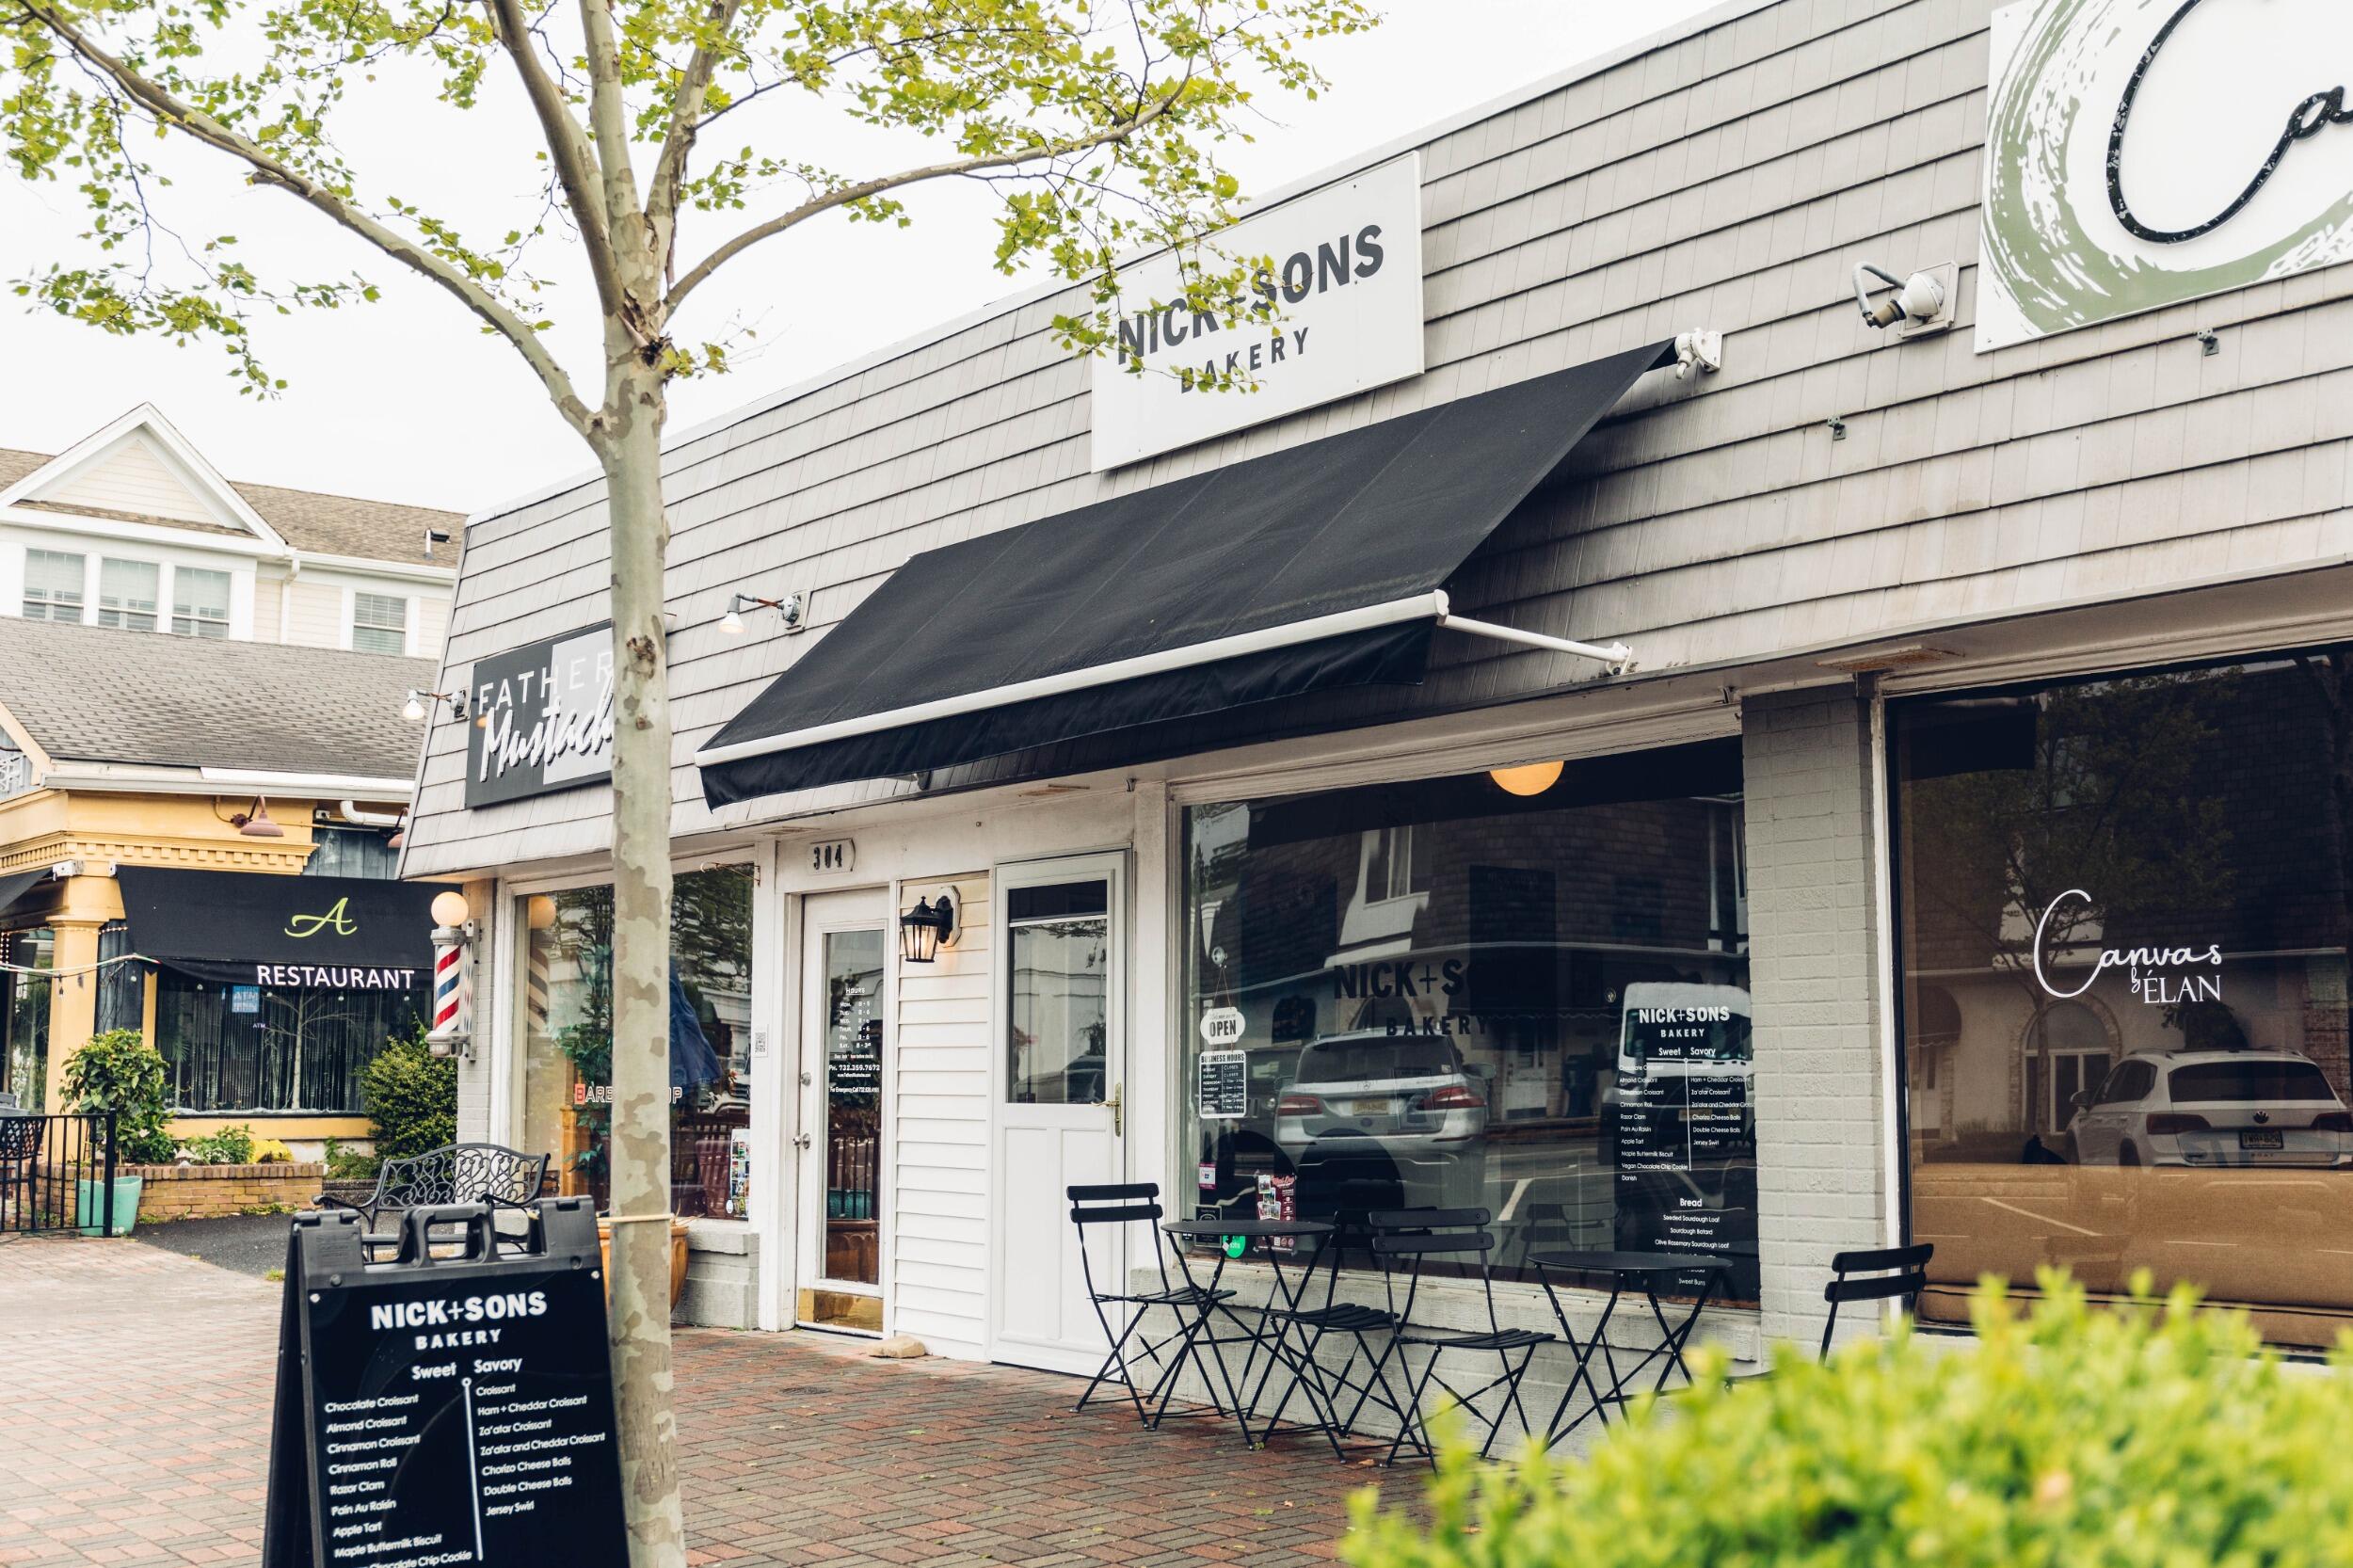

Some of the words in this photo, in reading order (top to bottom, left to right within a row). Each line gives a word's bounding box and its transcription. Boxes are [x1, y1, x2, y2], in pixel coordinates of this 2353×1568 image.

[813, 843, 843, 870] 304
[284, 897, 358, 938] A
[2034, 888, 2222, 998] Canvas
[257, 965, 415, 990] RESTAURANT
[1334, 958, 1464, 1000] NICK+S
[2130, 967, 2141, 993] by
[2143, 968, 2221, 1004] ÉLAN
[1639, 1005, 1730, 1024] NICK+SONS
[1209, 1019, 1237, 1037] OPEN
[1385, 1015, 1488, 1036] BAKERY
[1660, 1028, 1705, 1037] BAKERY
[1201, 1054, 1226, 1063] BUSINESS
[1226, 1053, 1244, 1062] HOURS
[1658, 1047, 1681, 1056] Sweet
[1690, 1047, 1716, 1057] Savory
[1679, 1197, 1703, 1208] Bread
[371, 1291, 548, 1330] NICK+SONS
[415, 1329, 503, 1350] BAKERY
[411, 1362, 457, 1380] Sweet
[473, 1358, 522, 1373] Savory
[475, 1384, 516, 1396] Croissant
[325, 1398, 376, 1413] Chocolate
[377, 1394, 419, 1407] Croissant
[477, 1406, 500, 1416] Ham
[508, 1400, 548, 1413] Cheddar
[549, 1395, 587, 1408] Croissant
[326, 1418, 364, 1433] Almond
[365, 1416, 408, 1429] Croissant
[327, 1440, 377, 1454] Cinnamon
[378, 1433, 421, 1448] Croissant
[328, 1461, 378, 1475] Cinnamon
[379, 1457, 398, 1469] Roll
[482, 1464, 517, 1477] Chorizo
[517, 1459, 552, 1472] Cheese
[552, 1456, 572, 1467] Balls
[329, 1483, 358, 1496] Razor
[359, 1480, 385, 1492] Clam
[484, 1483, 517, 1496] Double
[518, 1479, 552, 1492] Cheese
[552, 1476, 572, 1487] Balls
[331, 1505, 354, 1516] Pain
[354, 1502, 369, 1513] Au
[370, 1498, 397, 1511] Raisin
[486, 1504, 514, 1516] Jersey
[514, 1500, 535, 1512] Swirl
[332, 1524, 363, 1538] Apple
[363, 1521, 383, 1532] Tart
[334, 1544, 366, 1559] Maple
[366, 1538, 413, 1554] Buttermilk
[413, 1533, 442, 1546] Biscuit
[418, 1555, 440, 1567] Chip
[440, 1549, 472, 1563] Cookie
